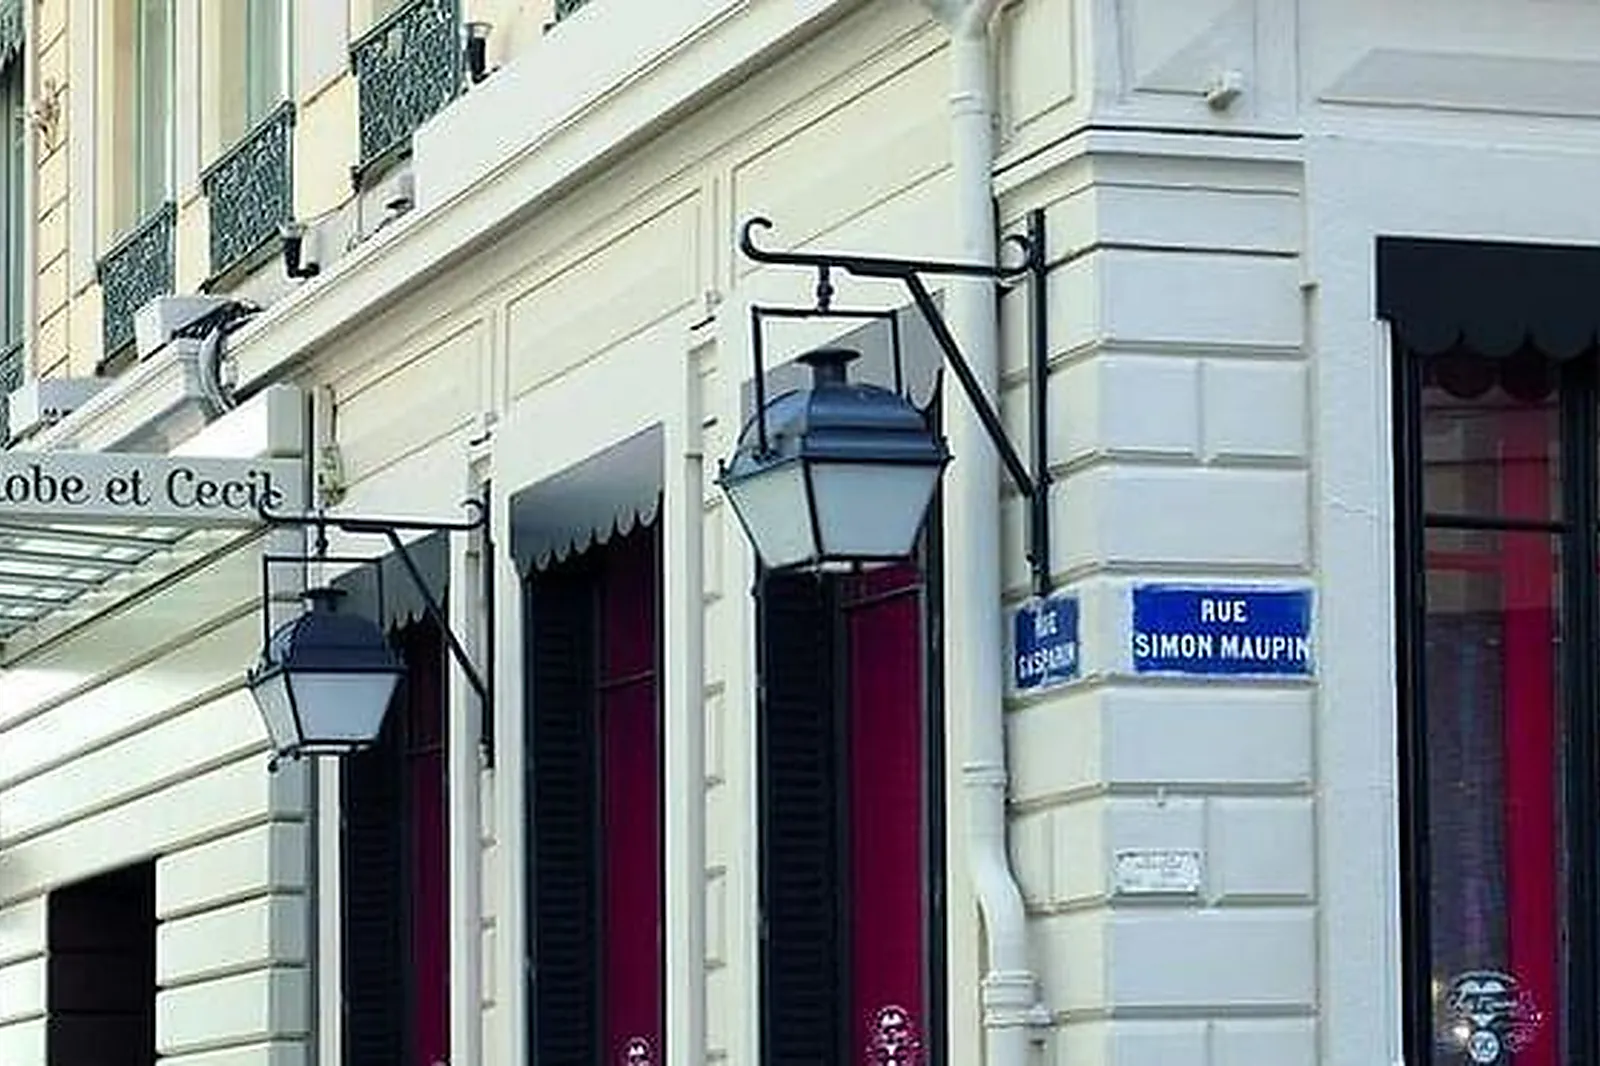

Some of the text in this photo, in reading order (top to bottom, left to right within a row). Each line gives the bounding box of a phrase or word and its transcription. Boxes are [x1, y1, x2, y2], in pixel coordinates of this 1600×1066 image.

[0, 464, 90, 504] obe
[105, 469, 150, 506] et
[1201, 599, 1247, 622] RUE
[1135, 634, 1310, 660] SIMON MAUPIN
